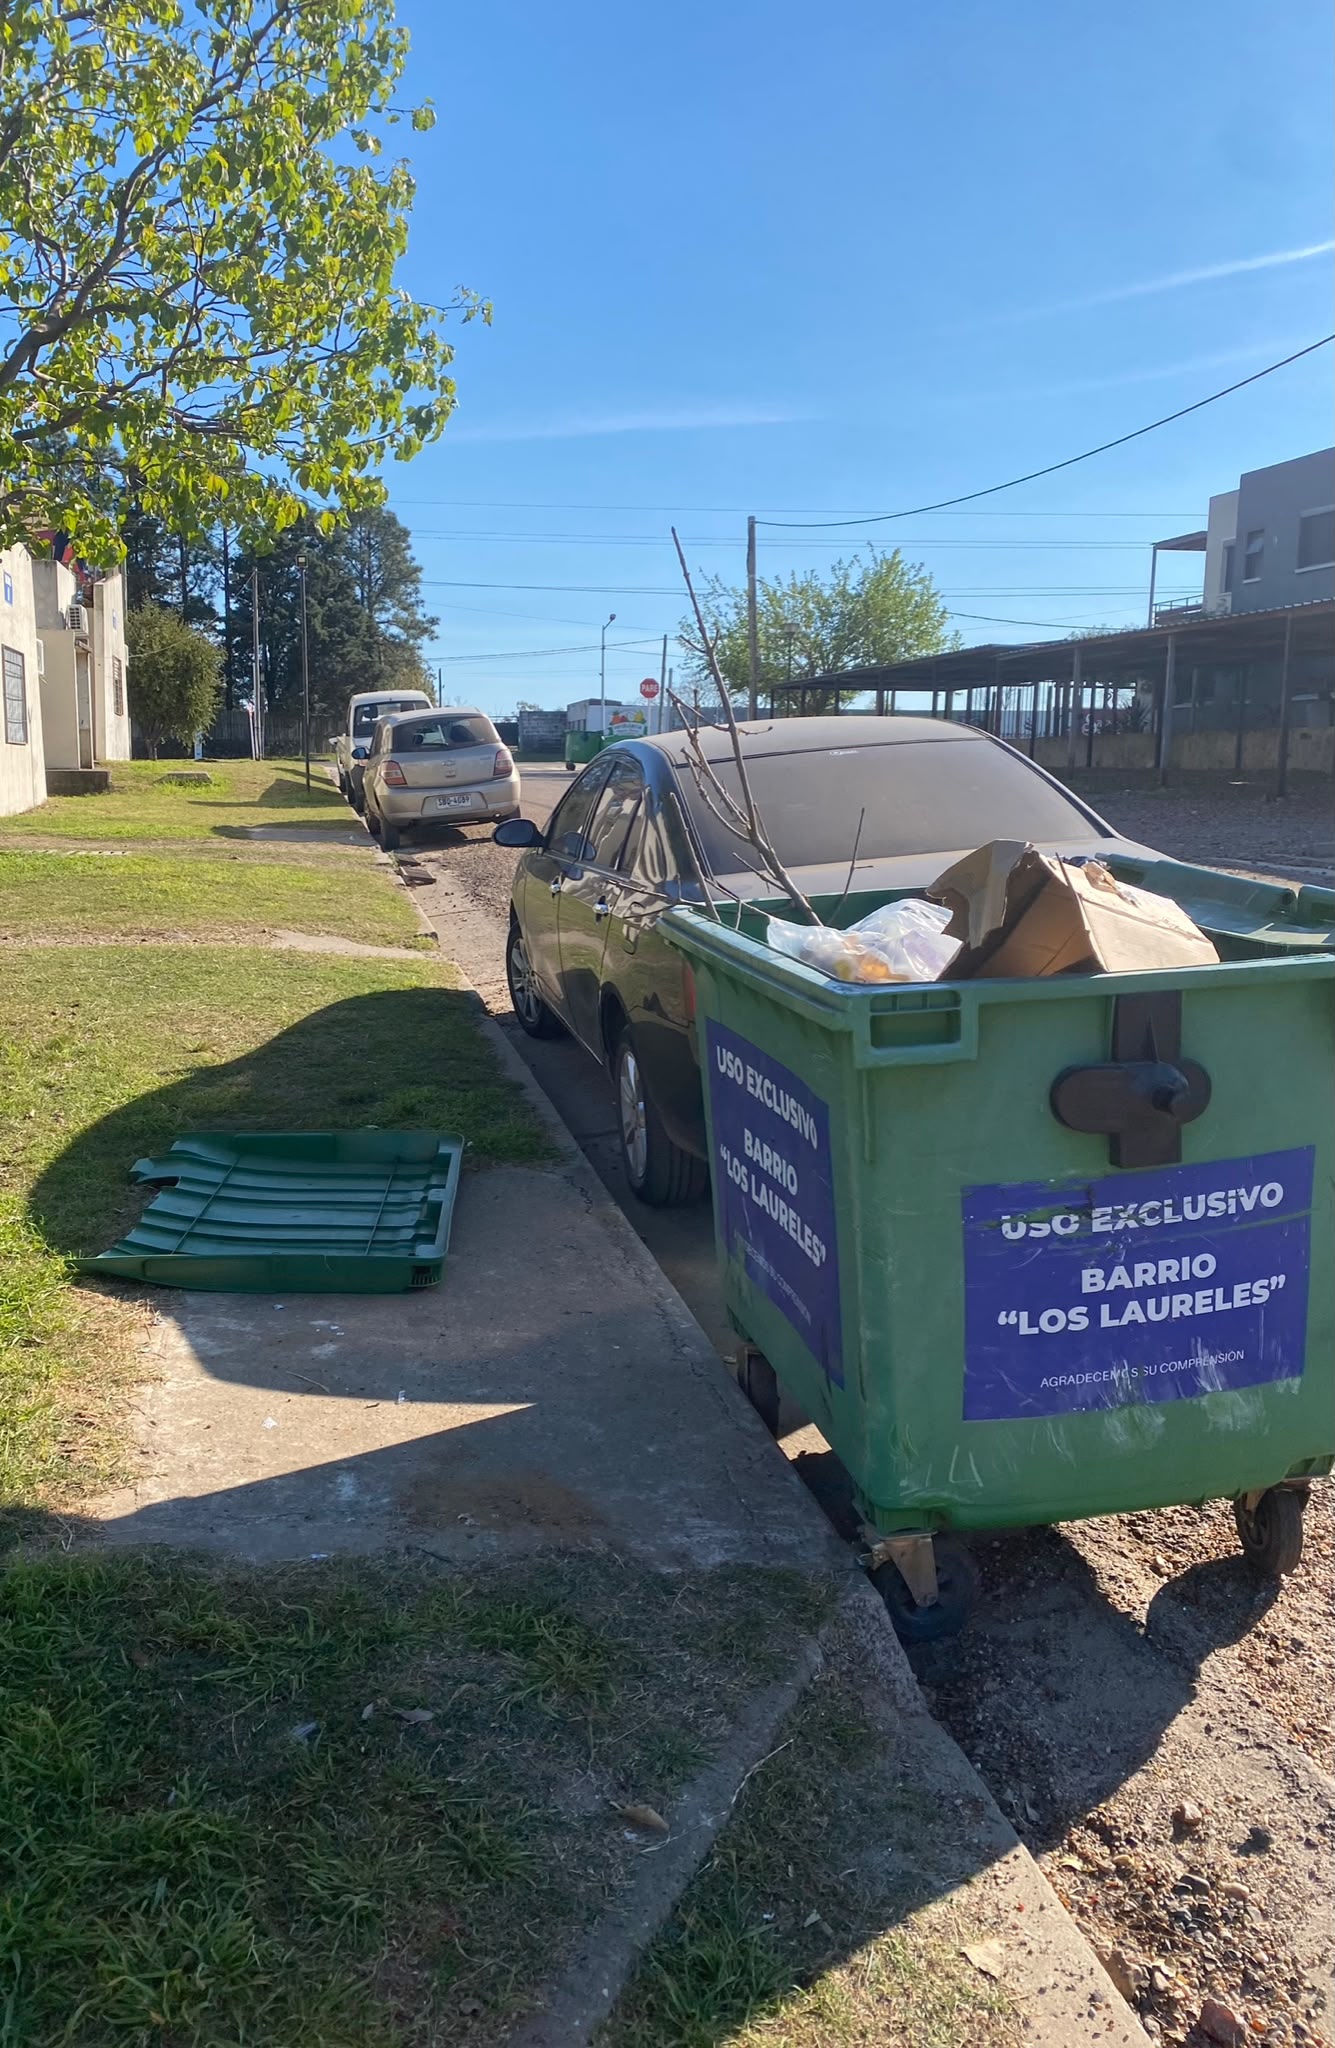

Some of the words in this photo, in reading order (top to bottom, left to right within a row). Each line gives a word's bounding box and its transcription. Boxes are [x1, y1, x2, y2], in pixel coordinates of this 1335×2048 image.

[641, 684, 658, 693] PARE
[716, 1045, 743, 1085] USO
[746, 1065, 818, 1149] EXCLUSIVO
[744, 1128, 798, 1196] BARRIO
[720, 1144, 748, 1193] “LOS
[751, 1174, 827, 1267] LAURELES”
[1091, 1182, 1284, 1233] EXCLUSIVO
[1081, 1253, 1217, 1293] BARRIO
[997, 1306, 1090, 1336] “LOS
[1100, 1274, 1286, 1328] LAURELES”
[1143, 1364, 1158, 1376] SU
